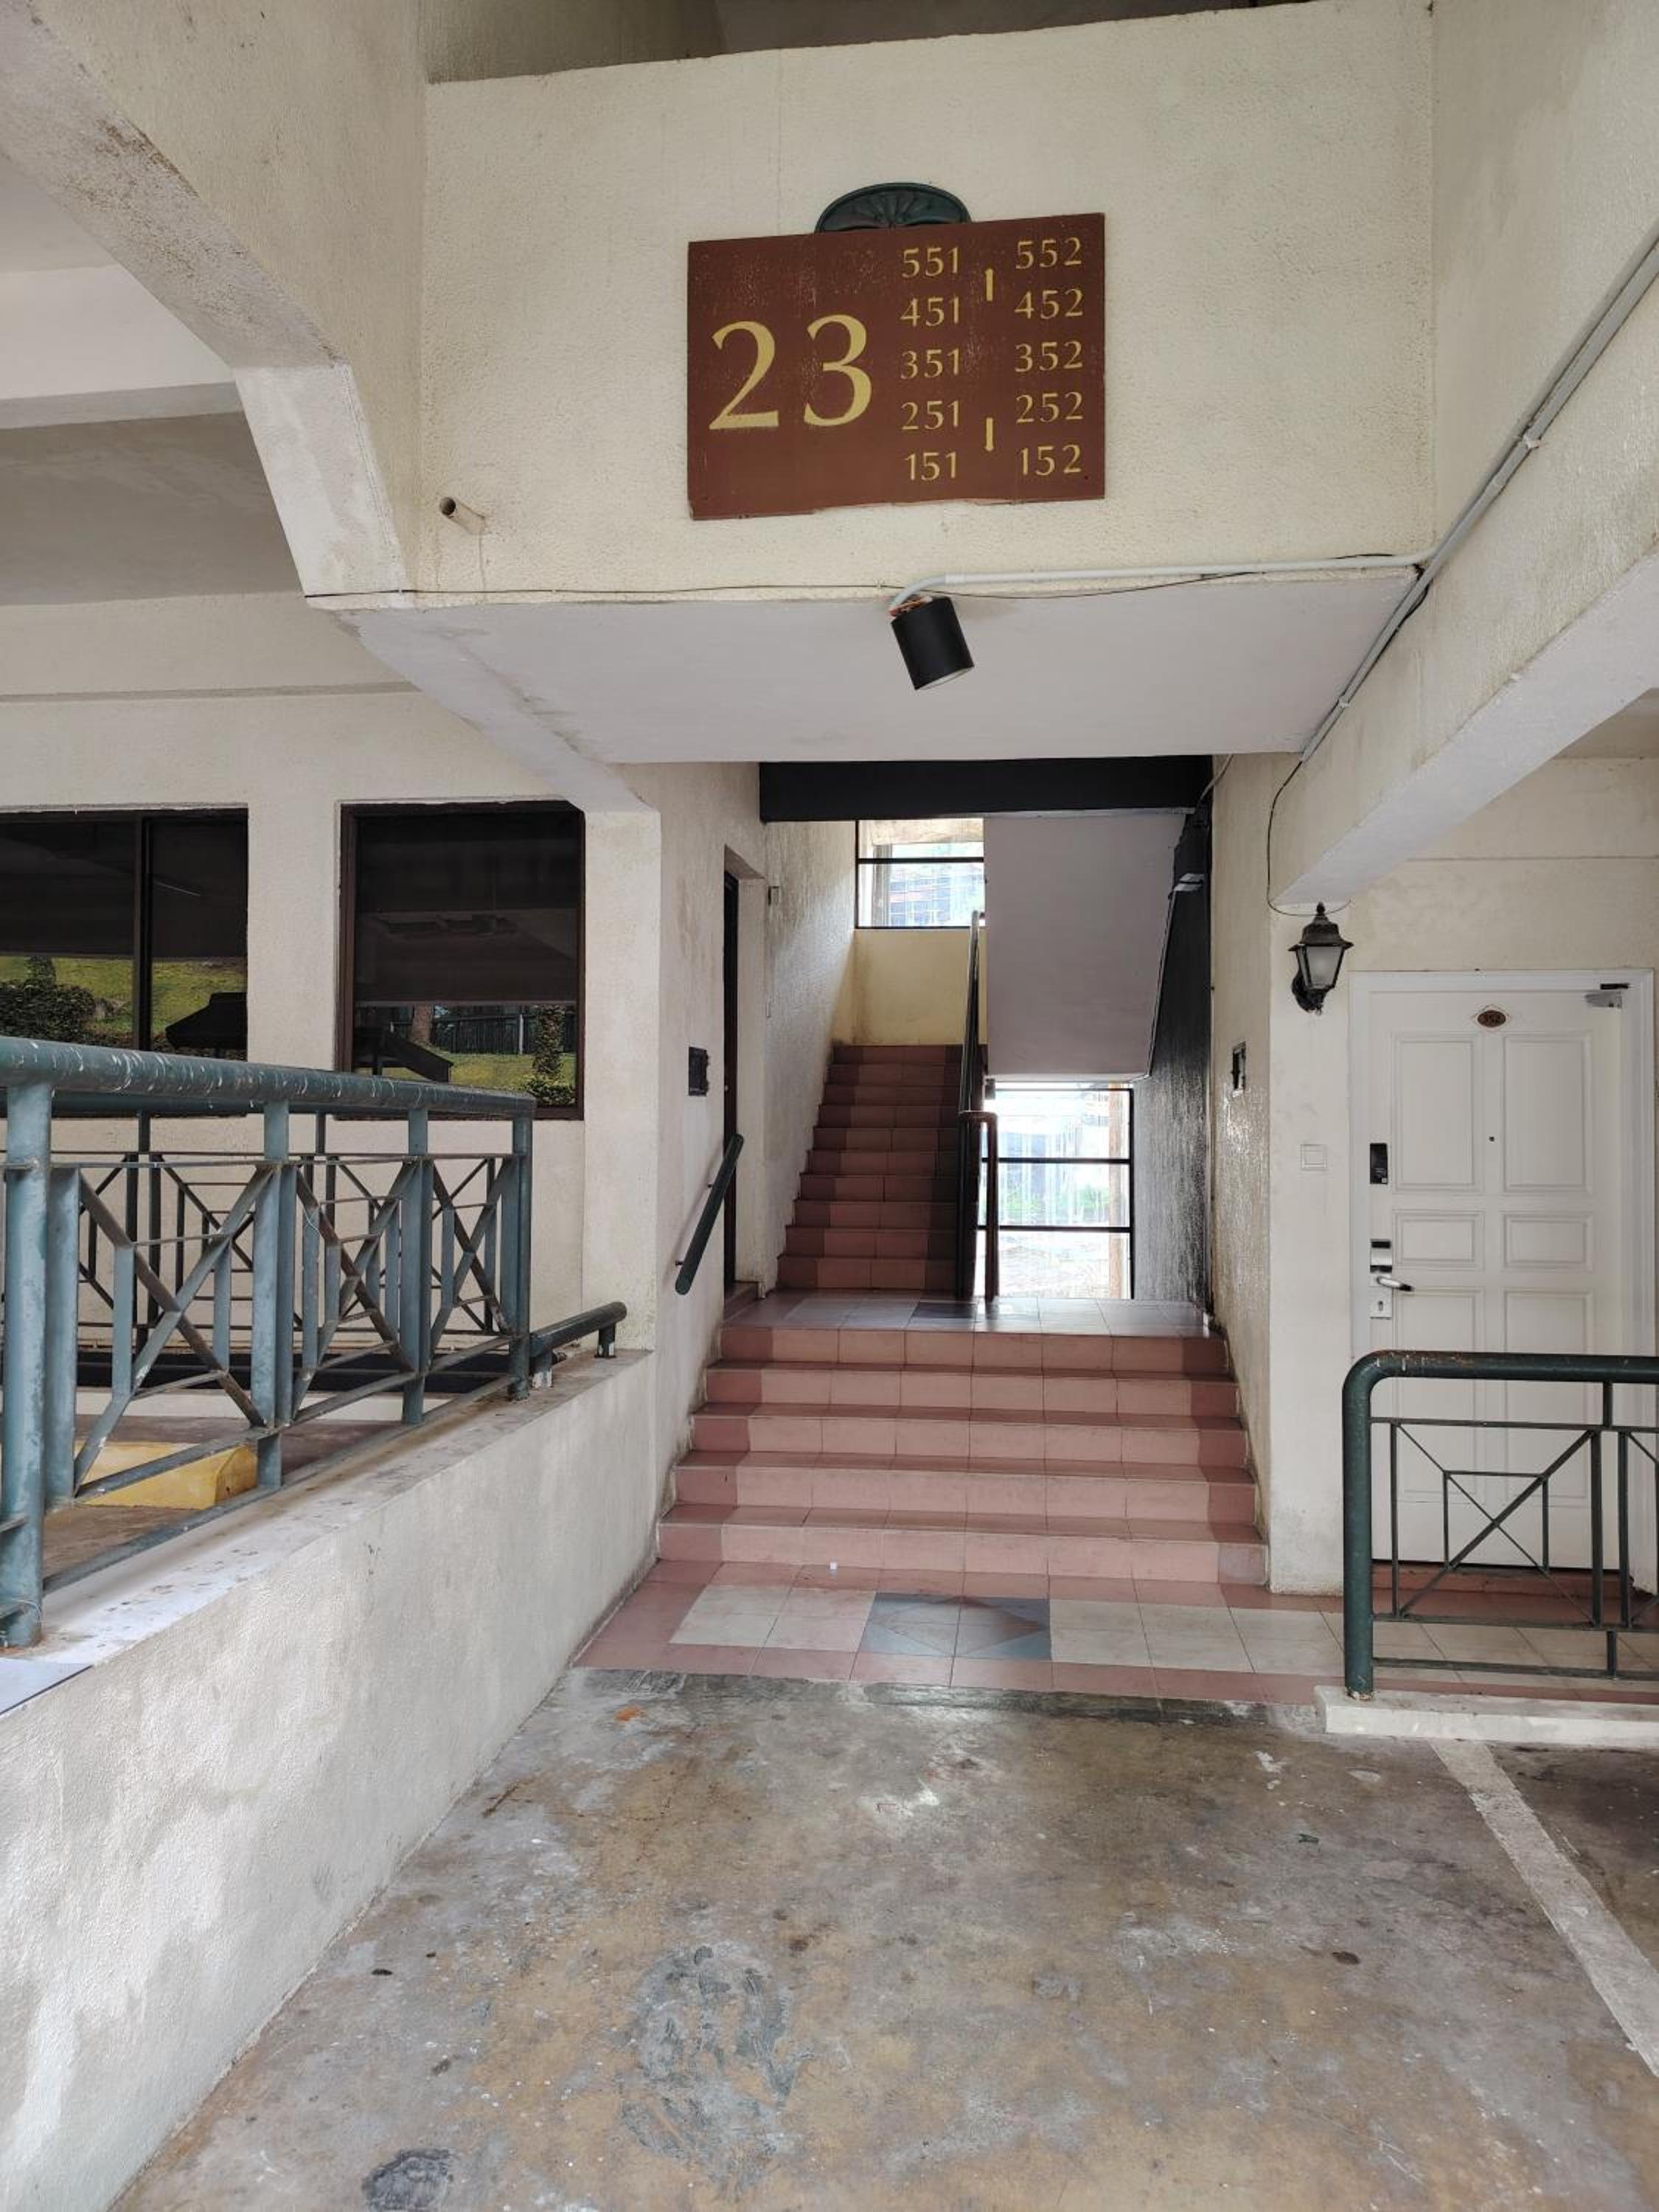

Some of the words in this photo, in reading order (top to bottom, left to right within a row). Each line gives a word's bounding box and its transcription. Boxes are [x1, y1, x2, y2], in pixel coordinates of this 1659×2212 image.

[901, 246, 959, 278] 551
[1015, 237, 1082, 269] 552
[900, 296, 959, 326] 451
[1014, 288, 1084, 319] 452
[900, 348, 959, 378] 351
[1014, 340, 1083, 372] 352
[709, 314, 873, 430] 23
[900, 400, 959, 430] 251
[1016, 392, 1084, 423] 252
[903, 451, 957, 480] 151
[1019, 445, 1082, 476] 152
